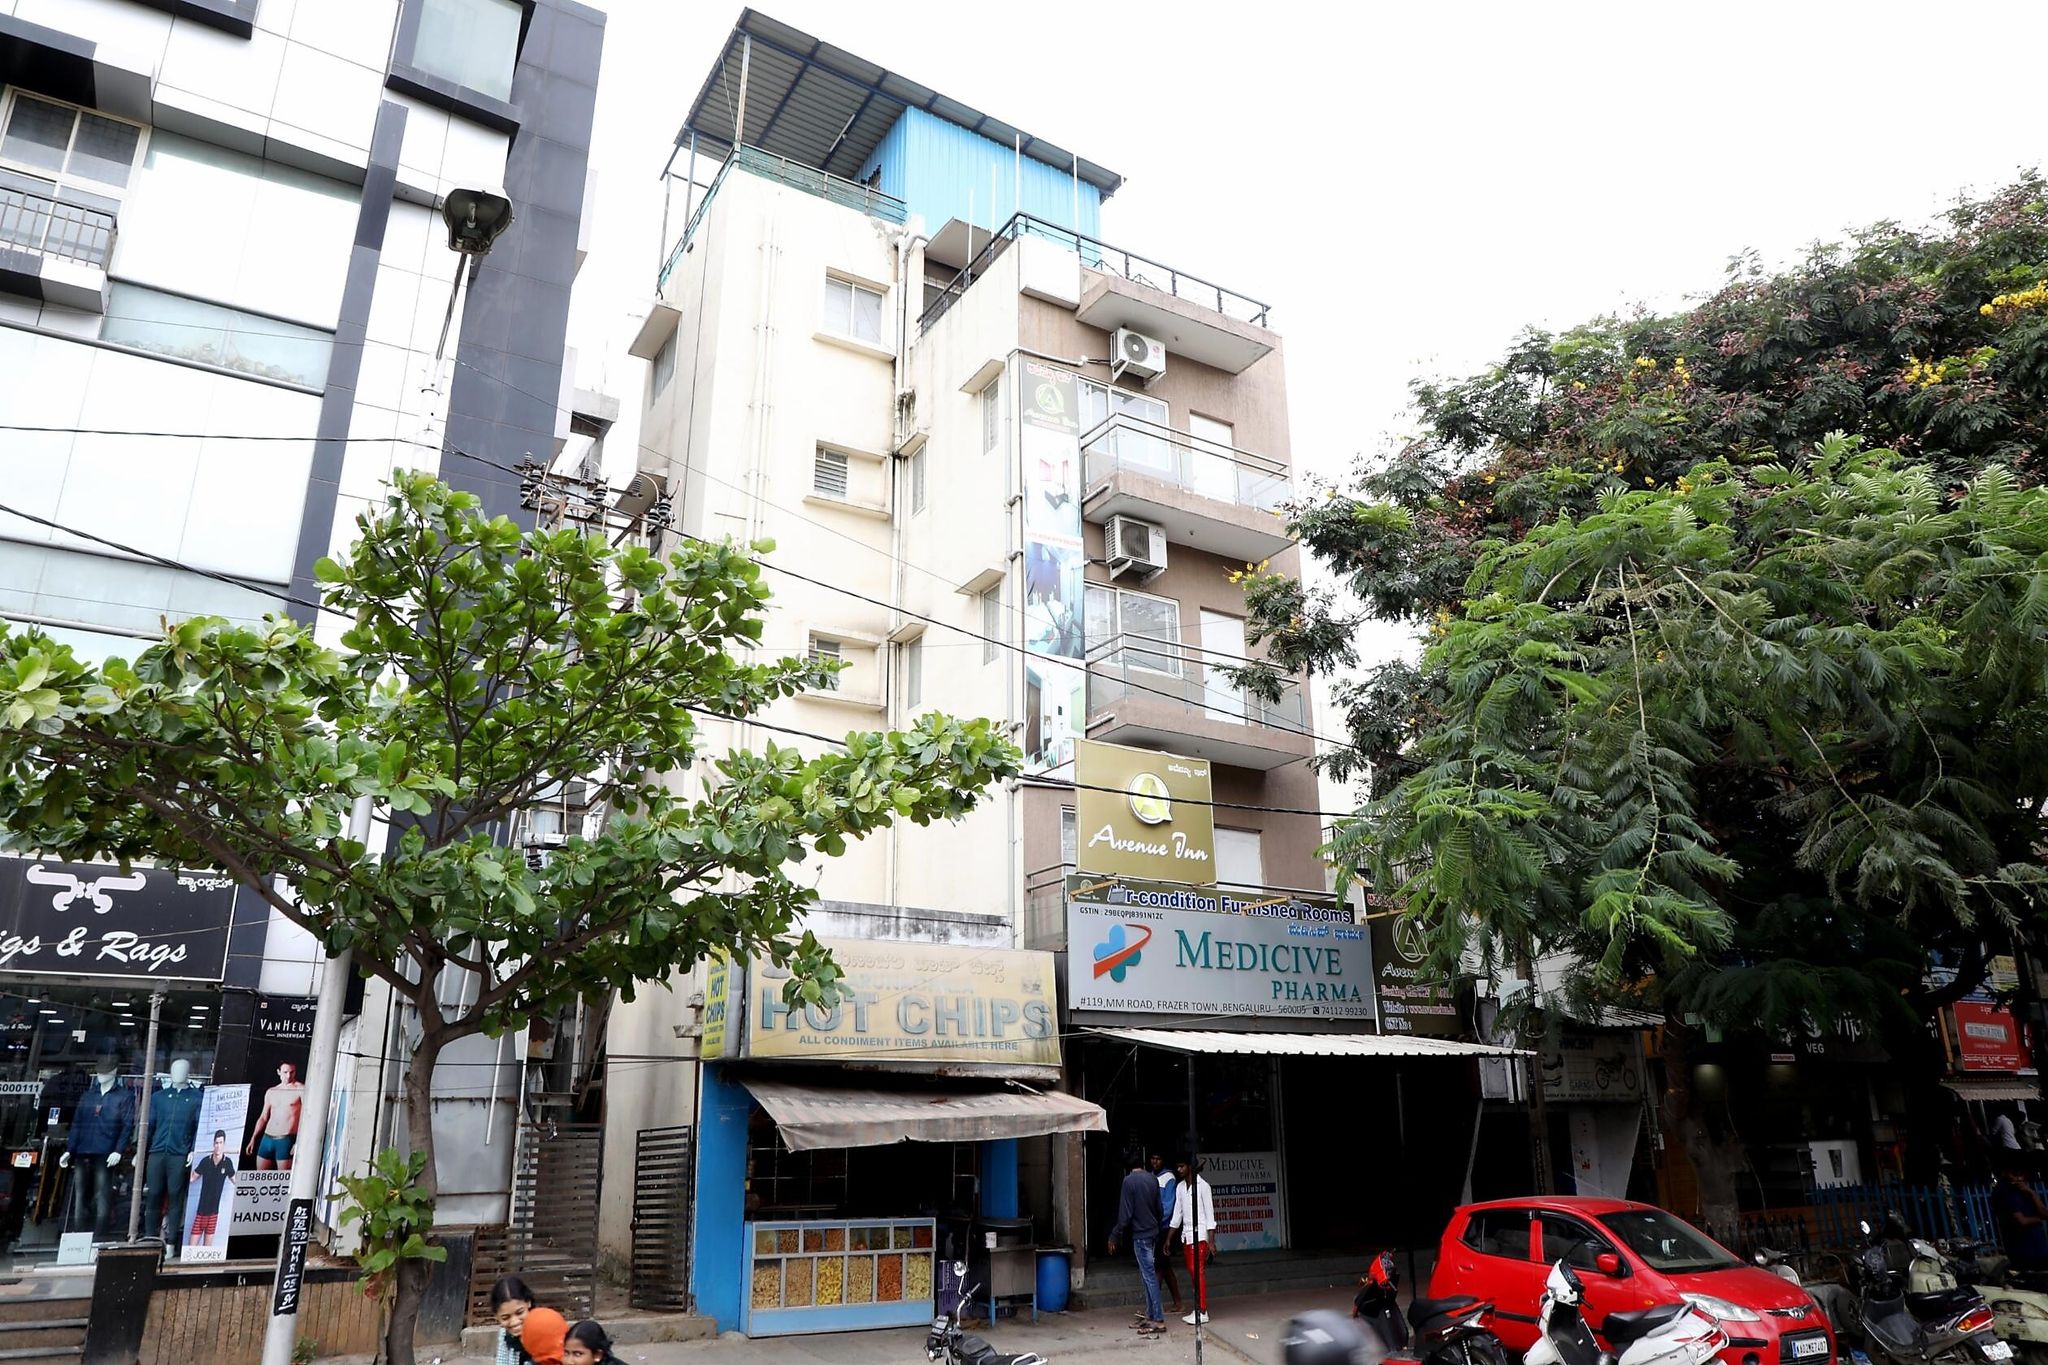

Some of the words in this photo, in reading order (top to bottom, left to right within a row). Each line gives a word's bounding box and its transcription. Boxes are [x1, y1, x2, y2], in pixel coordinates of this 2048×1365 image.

[1088, 824, 1168, 856] Avenue
[1172, 832, 1208, 861] Inn
[1080, 906, 1099, 915] GSTIN
[1301, 904, 1351, 924] Rooms
[57, 926, 88, 957] &
[96, 931, 187, 972] Rags
[1174, 929, 1343, 976] MEDICIVE
[1271, 980, 1362, 1003] PHARMA
[760, 986, 879, 1032] HOT
[897, 995, 1053, 1040] CHIPS
[1127, 999, 1155, 1010] ROAD,
[1157, 1000, 1189, 1010] FRAZER
[1192, 1002, 1218, 1012] TOWN
[1321, 1006, 1343, 1015] 74112
[1344, 1007, 1368, 1016] 99230
[799, 1034, 821, 1045] ALL
[824, 1036, 891, 1048] CONDIMENT
[894, 1038, 928, 1049] ITEMS
[931, 1039, 987, 1051] AVAILABLE
[990, 1041, 1019, 1052] HERE
[1806, 1043, 1825, 1054] VEG
[1209, 1157, 1265, 1172] MEDICIVE
[1240, 1171, 1271, 1180] PHARMA
[193, 1251, 223, 1259] JOCKEY
